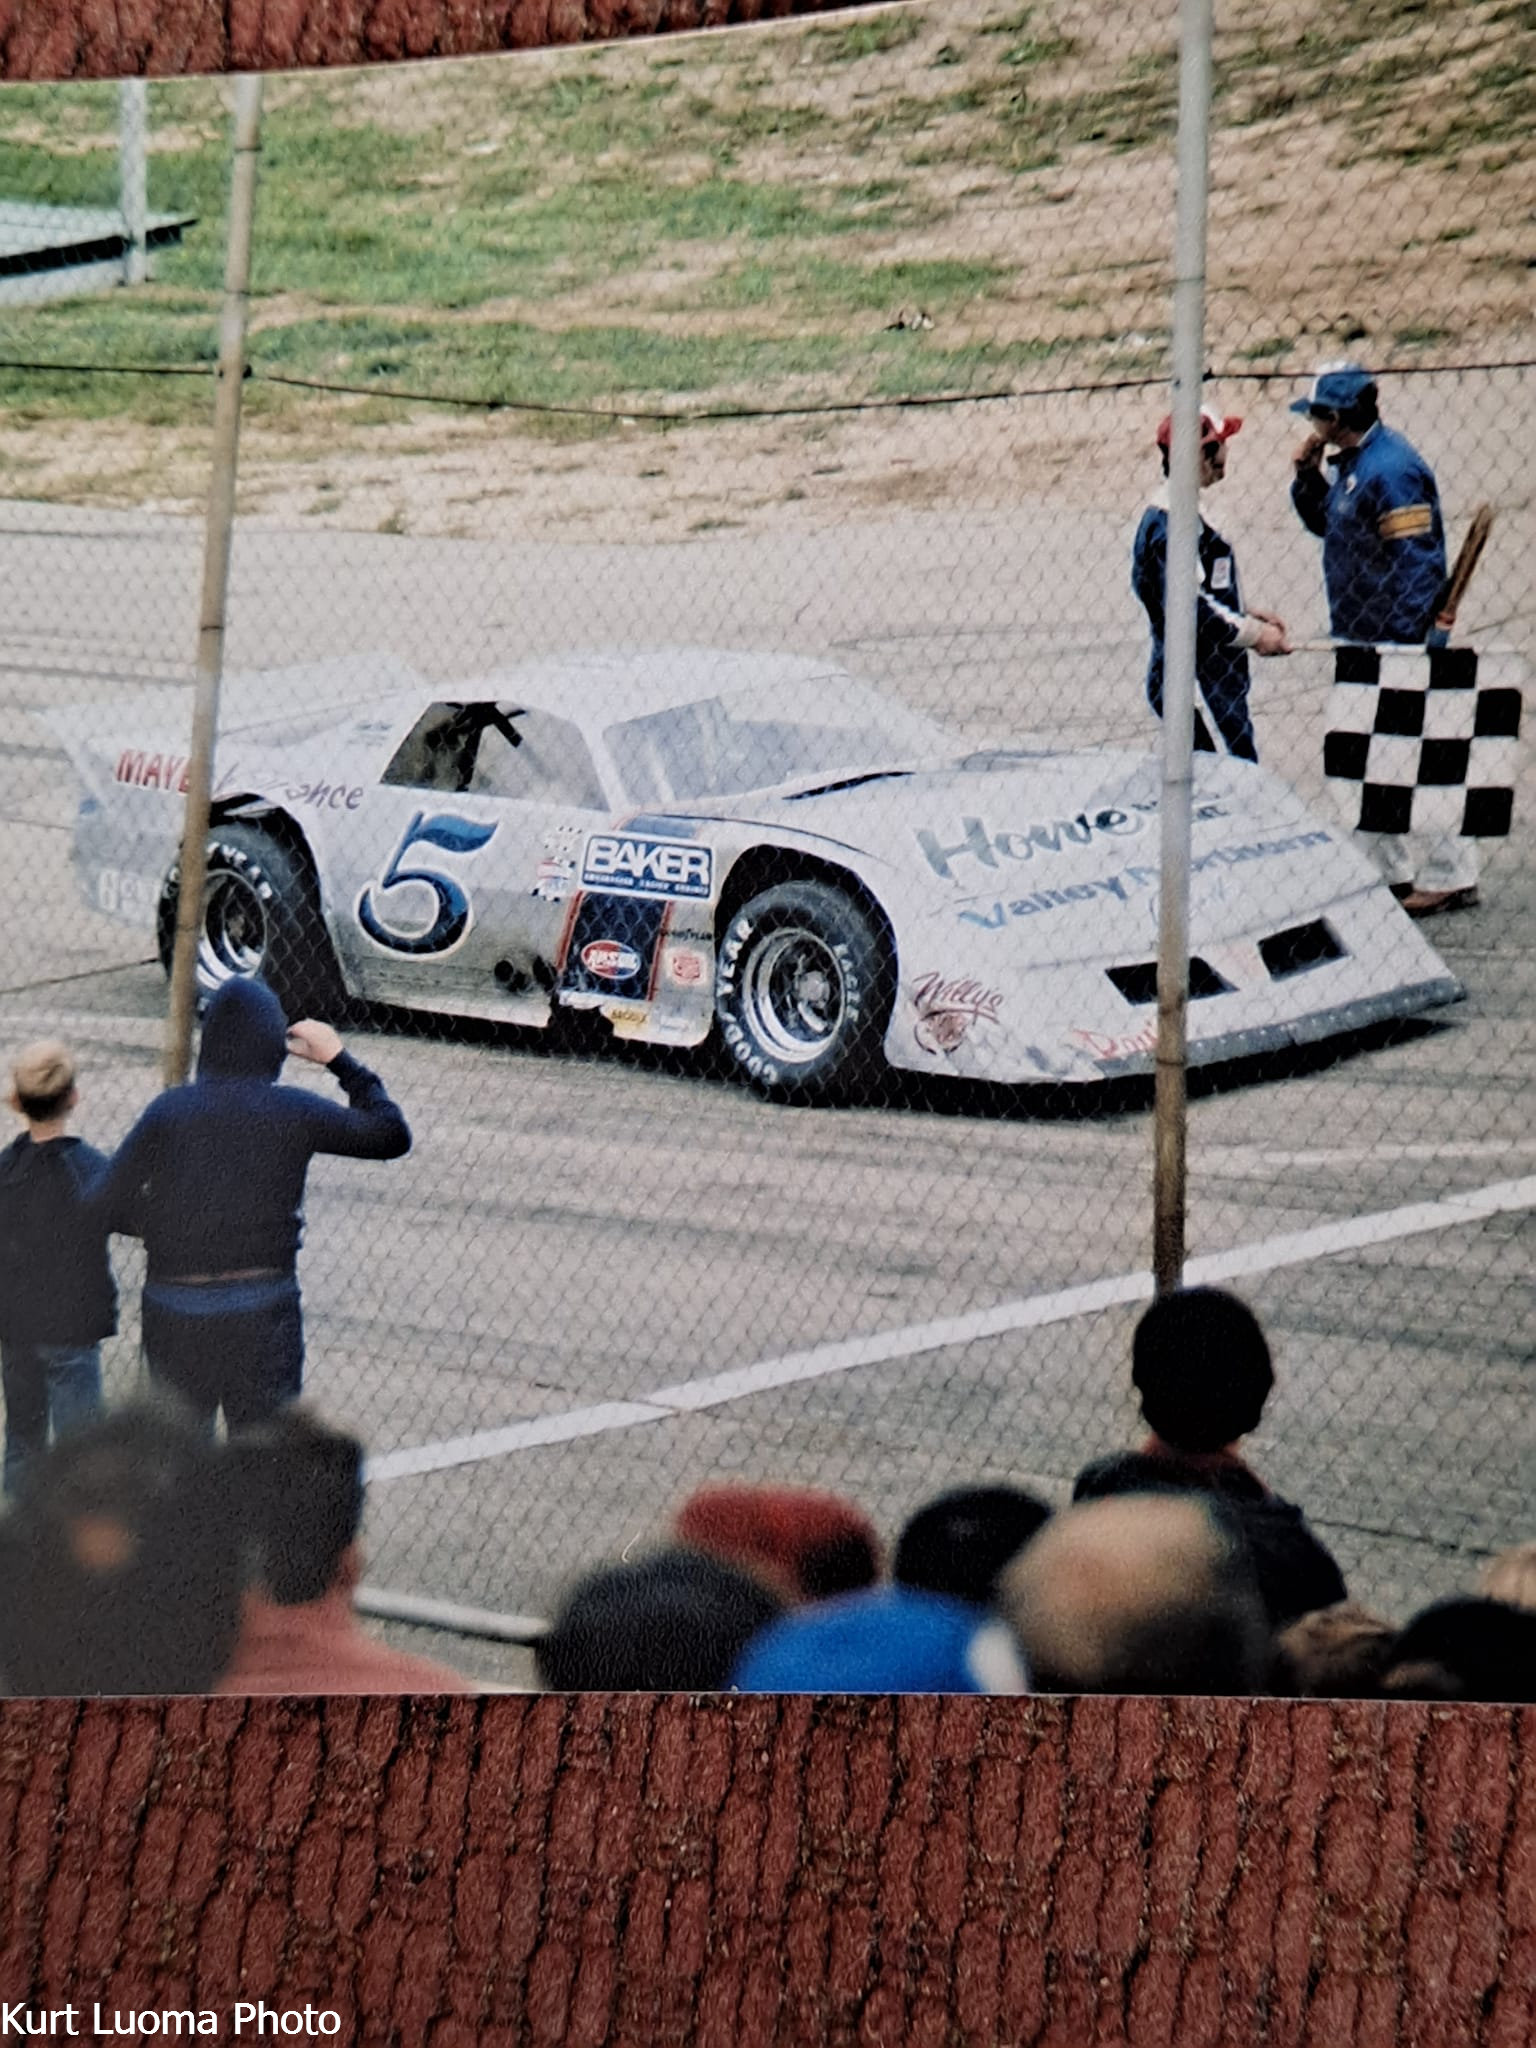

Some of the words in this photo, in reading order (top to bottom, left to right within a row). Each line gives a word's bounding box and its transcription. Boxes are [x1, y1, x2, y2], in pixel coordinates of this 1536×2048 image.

[585, 837, 710, 885] BAKER
[914, 807, 1143, 879] Howe
[355, 809, 500, 960] 5
[958, 876, 1128, 929] Valley
